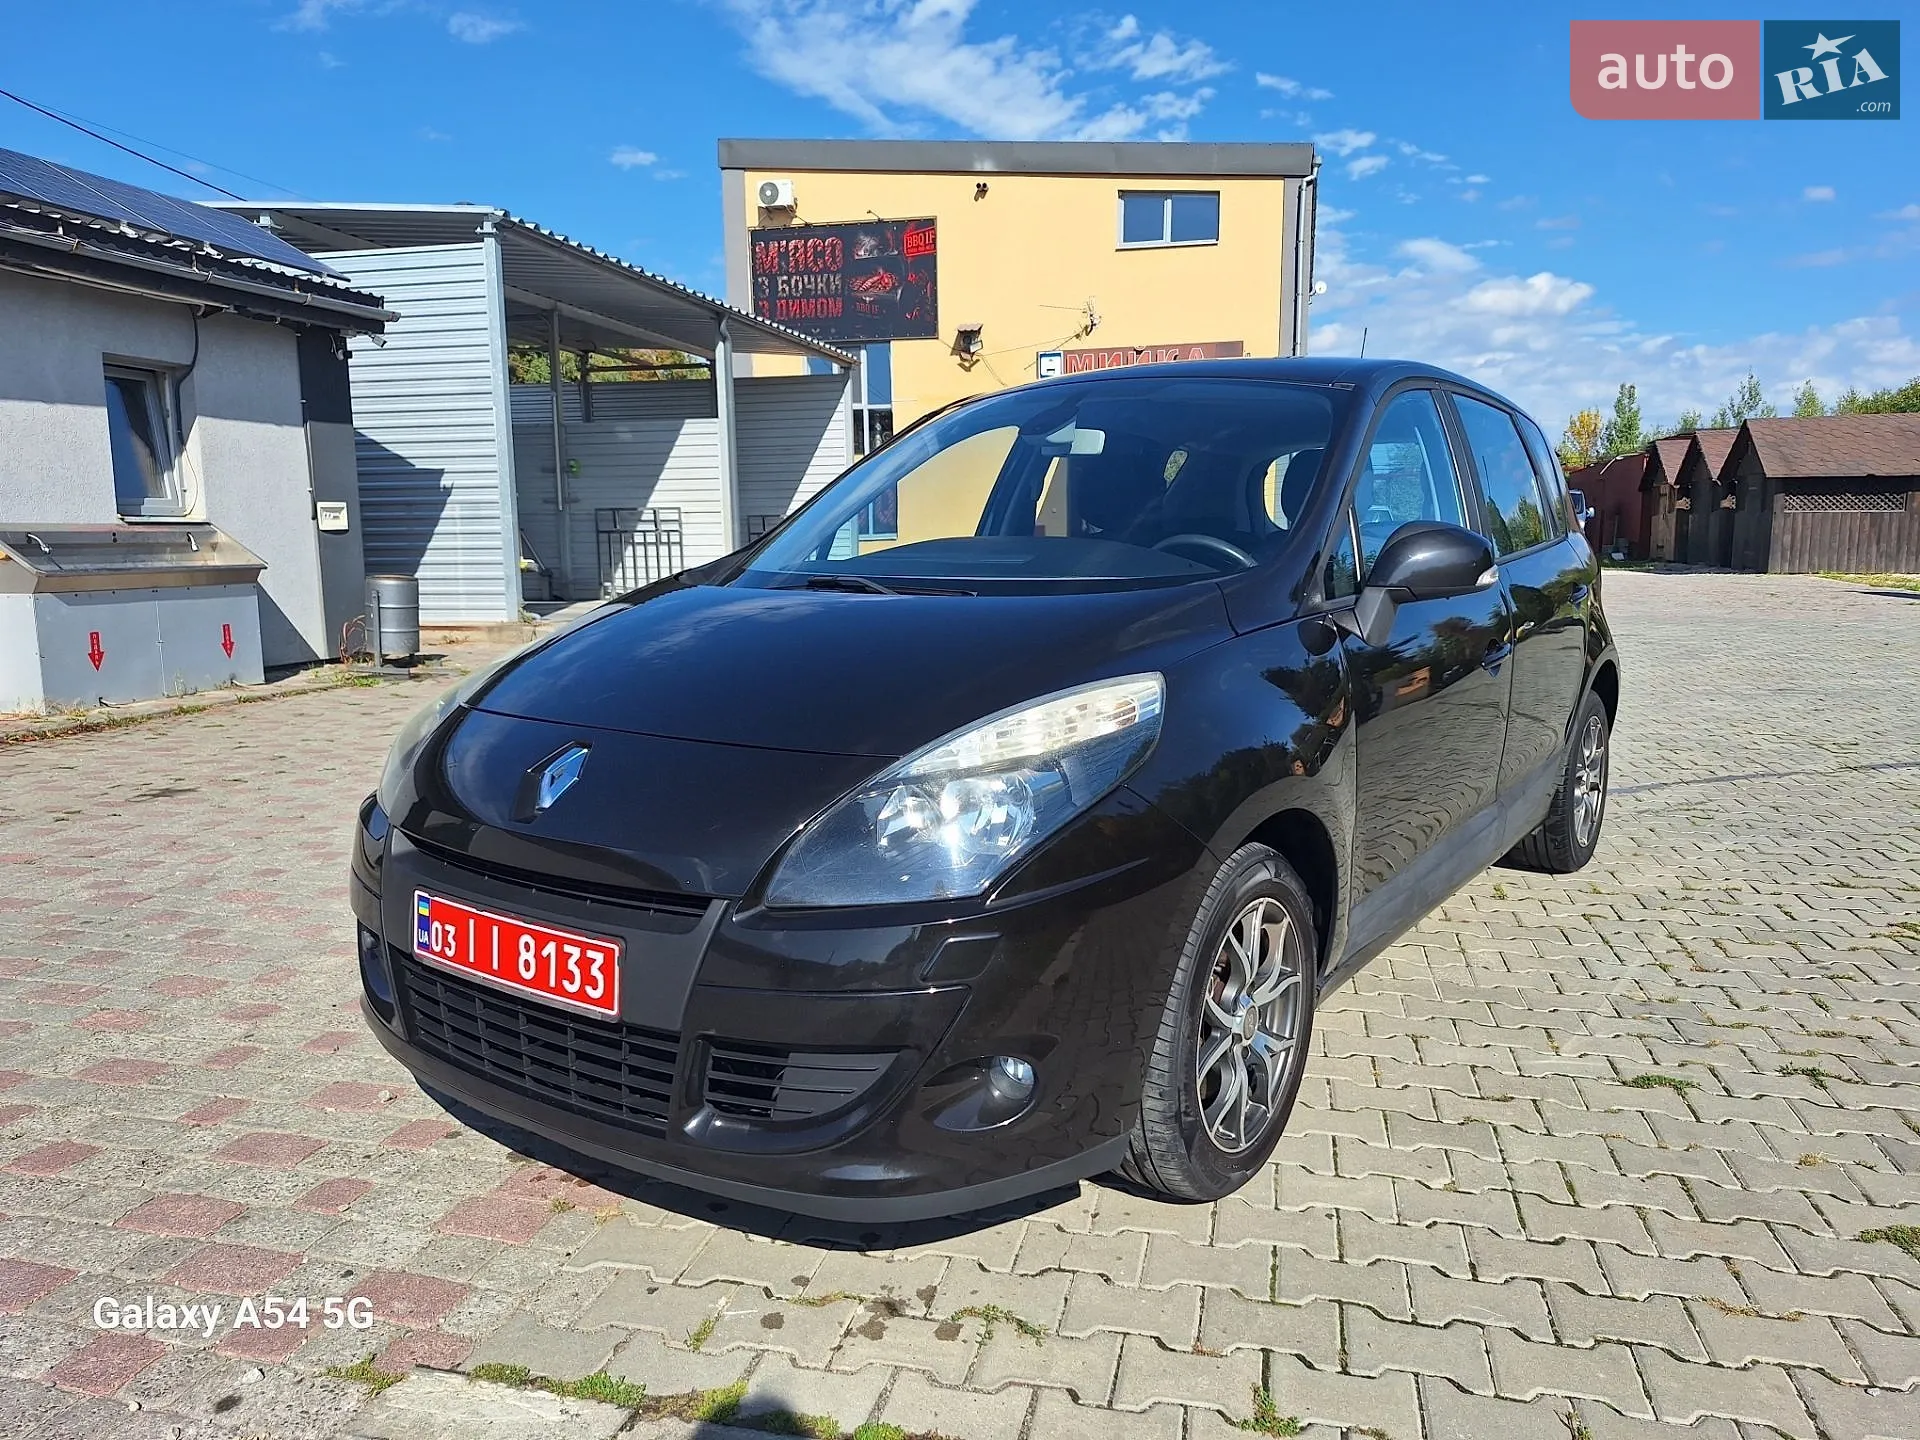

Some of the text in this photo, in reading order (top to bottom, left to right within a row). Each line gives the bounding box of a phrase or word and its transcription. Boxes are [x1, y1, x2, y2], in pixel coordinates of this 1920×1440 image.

[907, 233, 925, 248] BBQ
[776, 273, 842, 298] БОЧКИ
[776, 296, 843, 321] ДИМОМ
[418, 928, 429, 945] UA
[431, 920, 457, 958] 03
[518, 933, 605, 999] 8133
